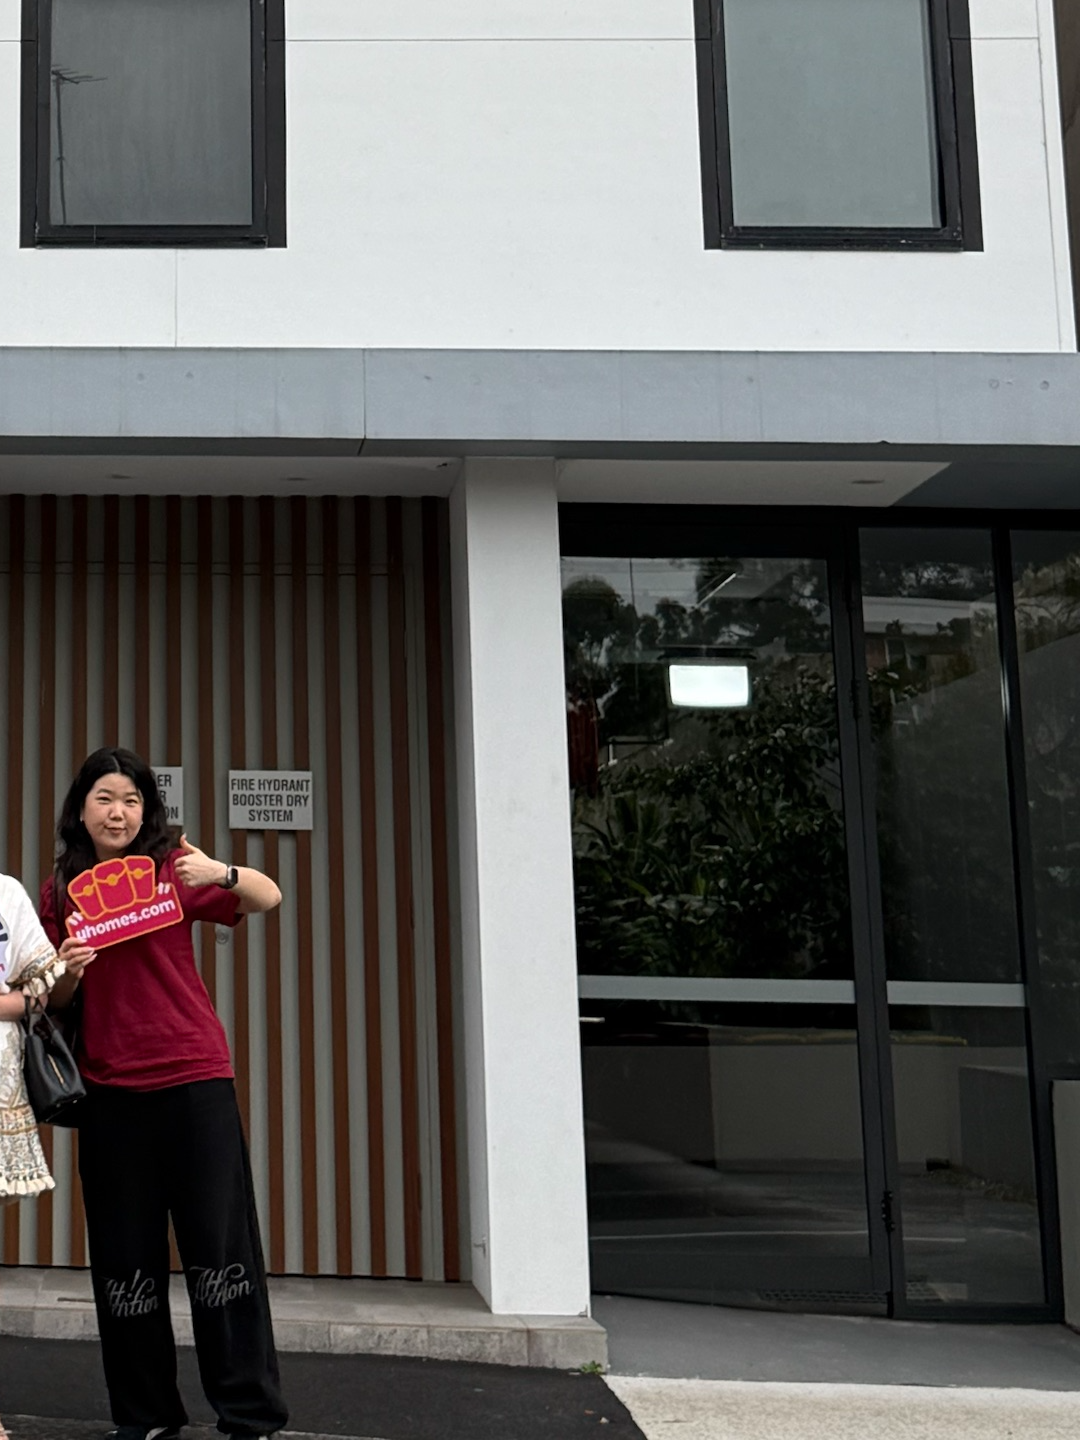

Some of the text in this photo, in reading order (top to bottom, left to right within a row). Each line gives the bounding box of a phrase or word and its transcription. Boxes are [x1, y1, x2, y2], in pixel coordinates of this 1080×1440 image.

[231, 778, 310, 792] FIRE HYDRANT
[232, 794, 309, 807] BOOSTER DRY
[248, 809, 293, 822] SYSTEM
[76, 900, 176, 940] uhomes.com
